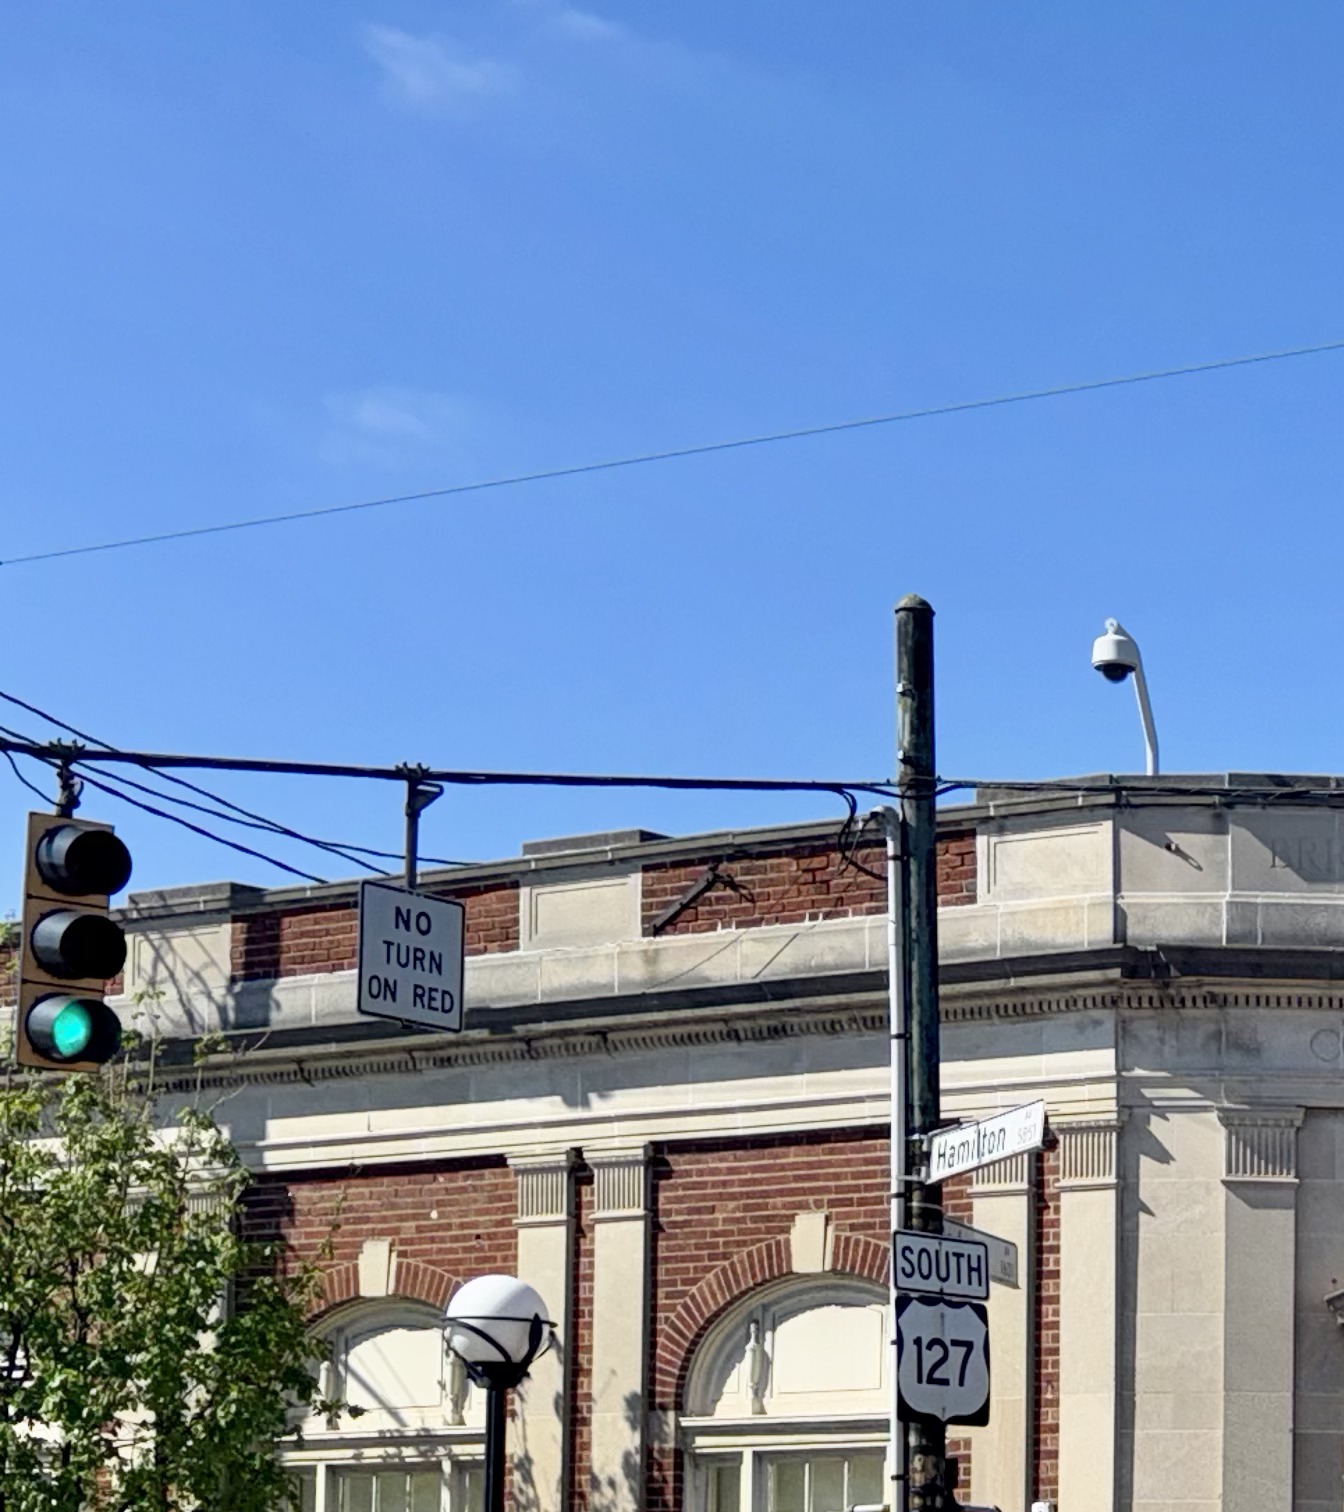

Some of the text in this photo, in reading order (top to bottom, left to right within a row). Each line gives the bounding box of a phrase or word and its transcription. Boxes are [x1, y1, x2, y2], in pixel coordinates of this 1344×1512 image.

[395, 906, 432, 936] NO
[382, 940, 442, 977] TURN
[368, 974, 455, 1014] ON RED
[936, 1124, 1006, 1171] Hamilton
[900, 1245, 984, 1288] SOUTH
[912, 1336, 975, 1387] 127
